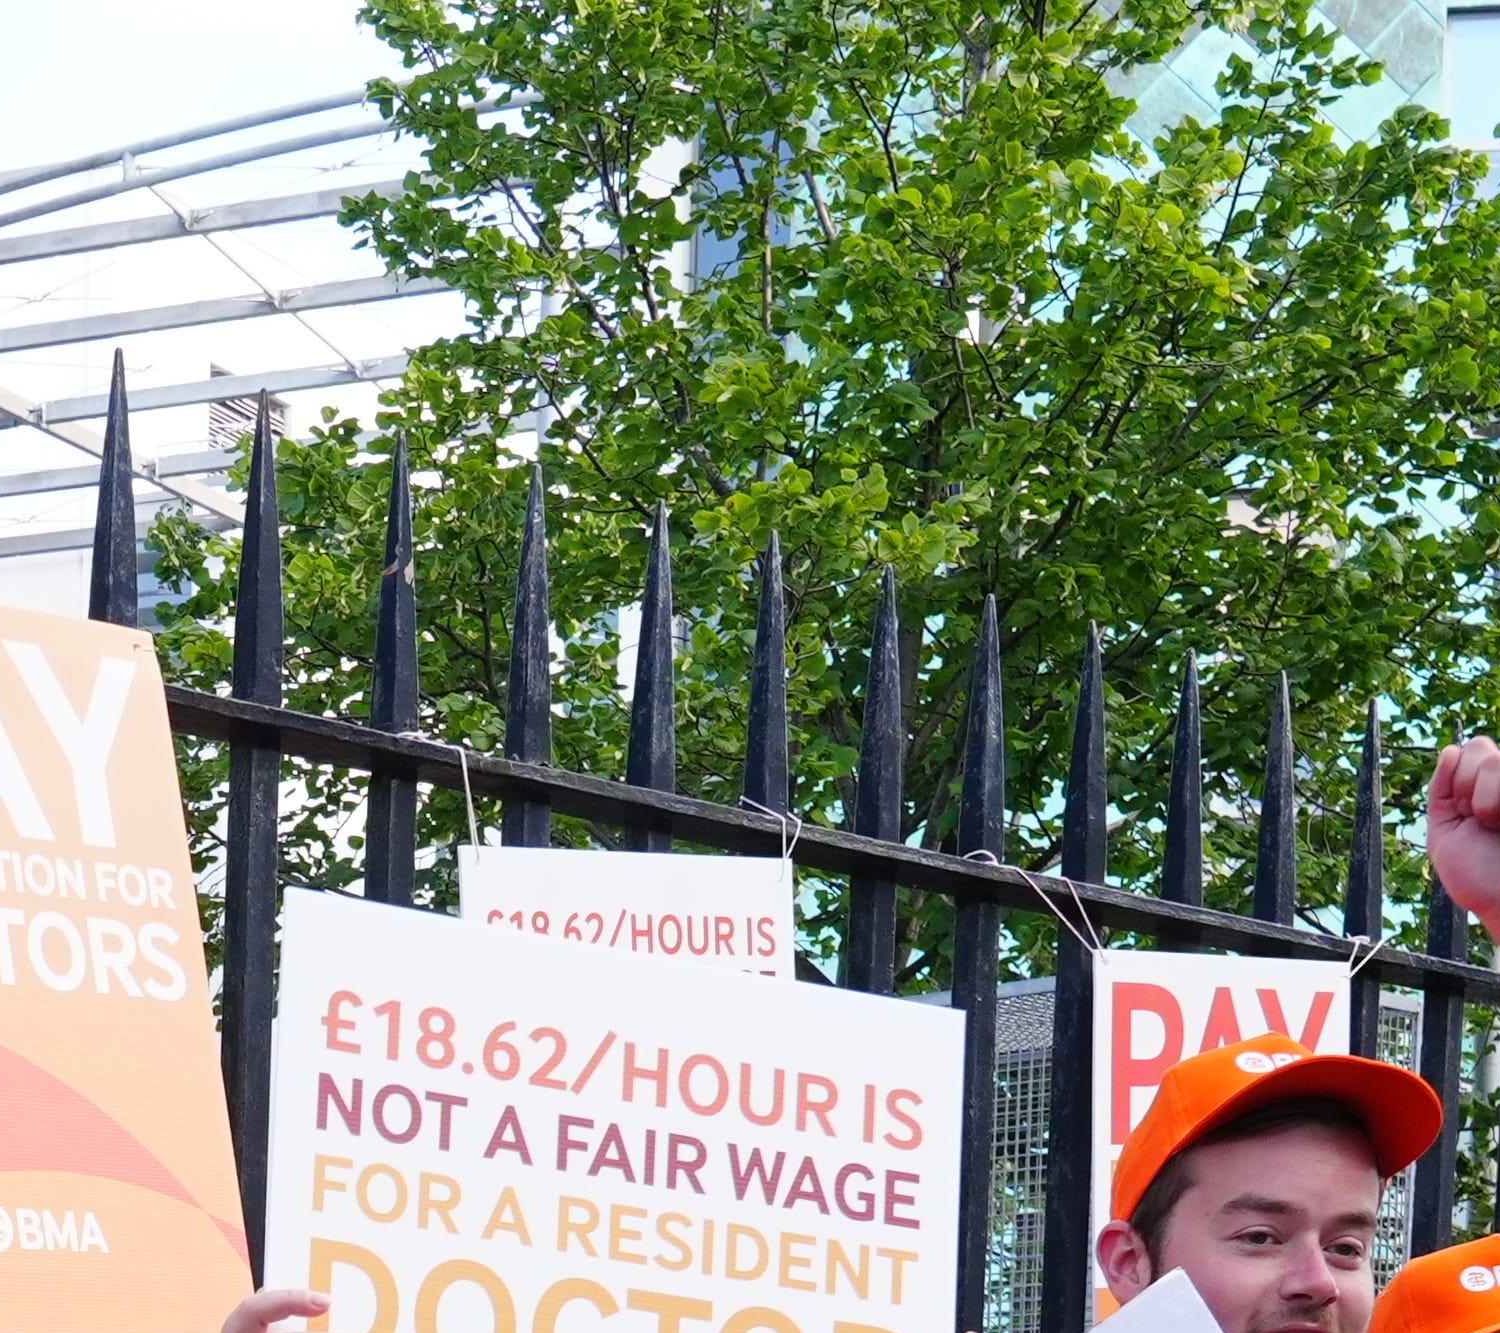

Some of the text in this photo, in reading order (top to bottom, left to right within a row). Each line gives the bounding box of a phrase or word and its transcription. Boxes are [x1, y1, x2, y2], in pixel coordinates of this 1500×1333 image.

[94, 860, 177, 911] FOR
[747, 917, 776, 957] IS
[321, 989, 924, 1151] £18.62/HOUR IS
[316, 1072, 921, 1230] NOT A FAIR WAGE
[17, 1210, 110, 1255] BMA
[311, 1153, 920, 1307] FOR A RESIDENT
